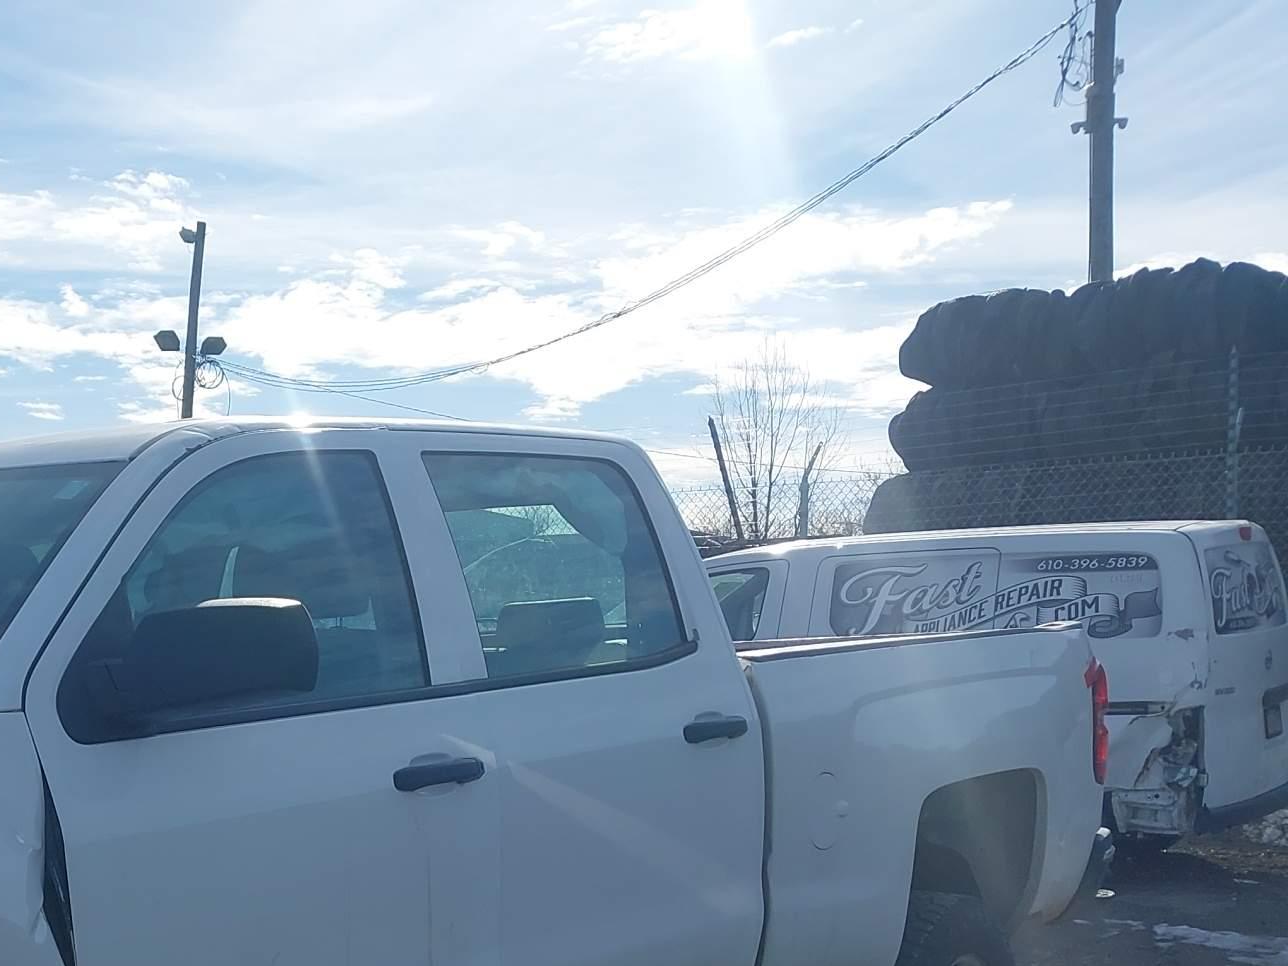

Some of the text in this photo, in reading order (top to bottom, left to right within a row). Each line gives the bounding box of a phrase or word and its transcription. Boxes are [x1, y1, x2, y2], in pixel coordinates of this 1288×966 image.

[1037, 556, 1148, 571] 610-396-5839
[840, 560, 983, 635] Fast
[994, 578, 1063, 613] REPAIR
